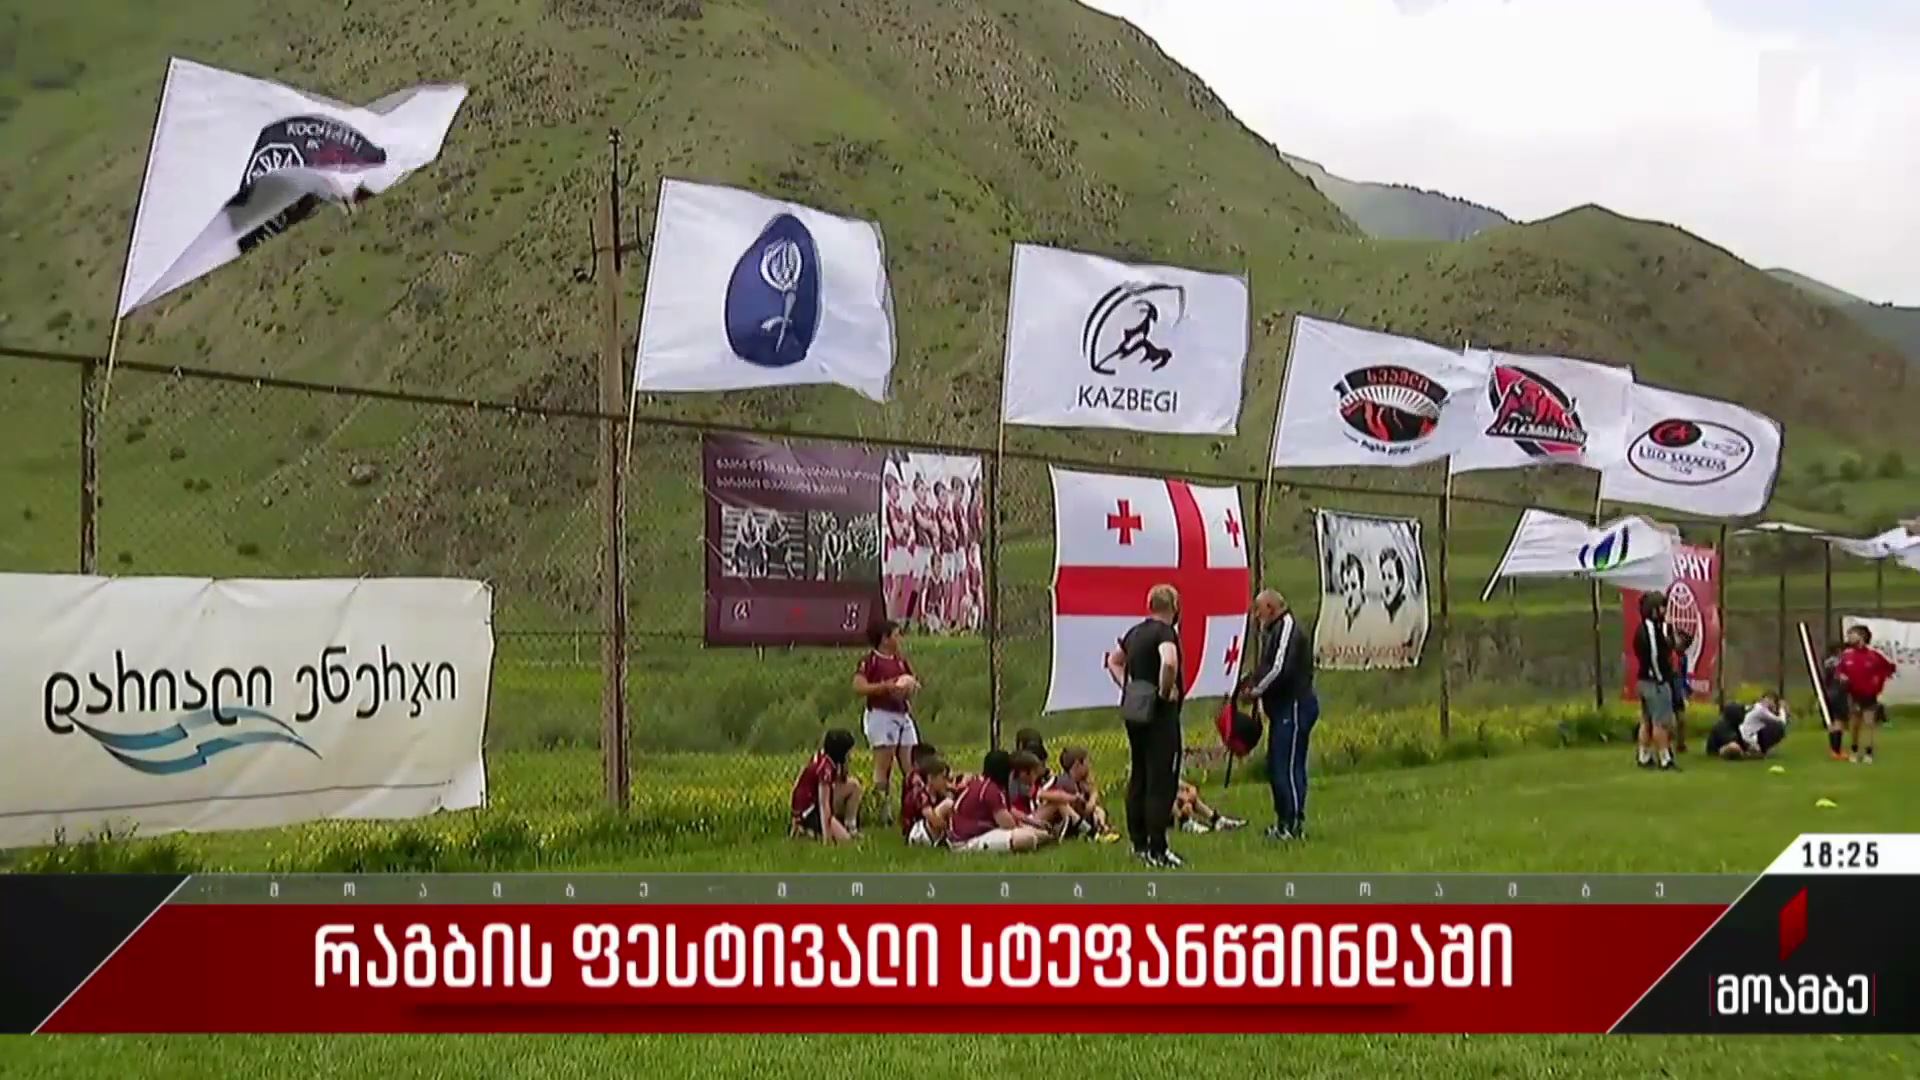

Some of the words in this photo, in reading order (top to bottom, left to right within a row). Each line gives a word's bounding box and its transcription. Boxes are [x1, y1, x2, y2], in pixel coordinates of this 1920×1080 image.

[1078, 385, 1178, 413] KAZBEGI
[44, 650, 273, 734] დარიალი
[295, 644, 456, 719] ენერჯი
